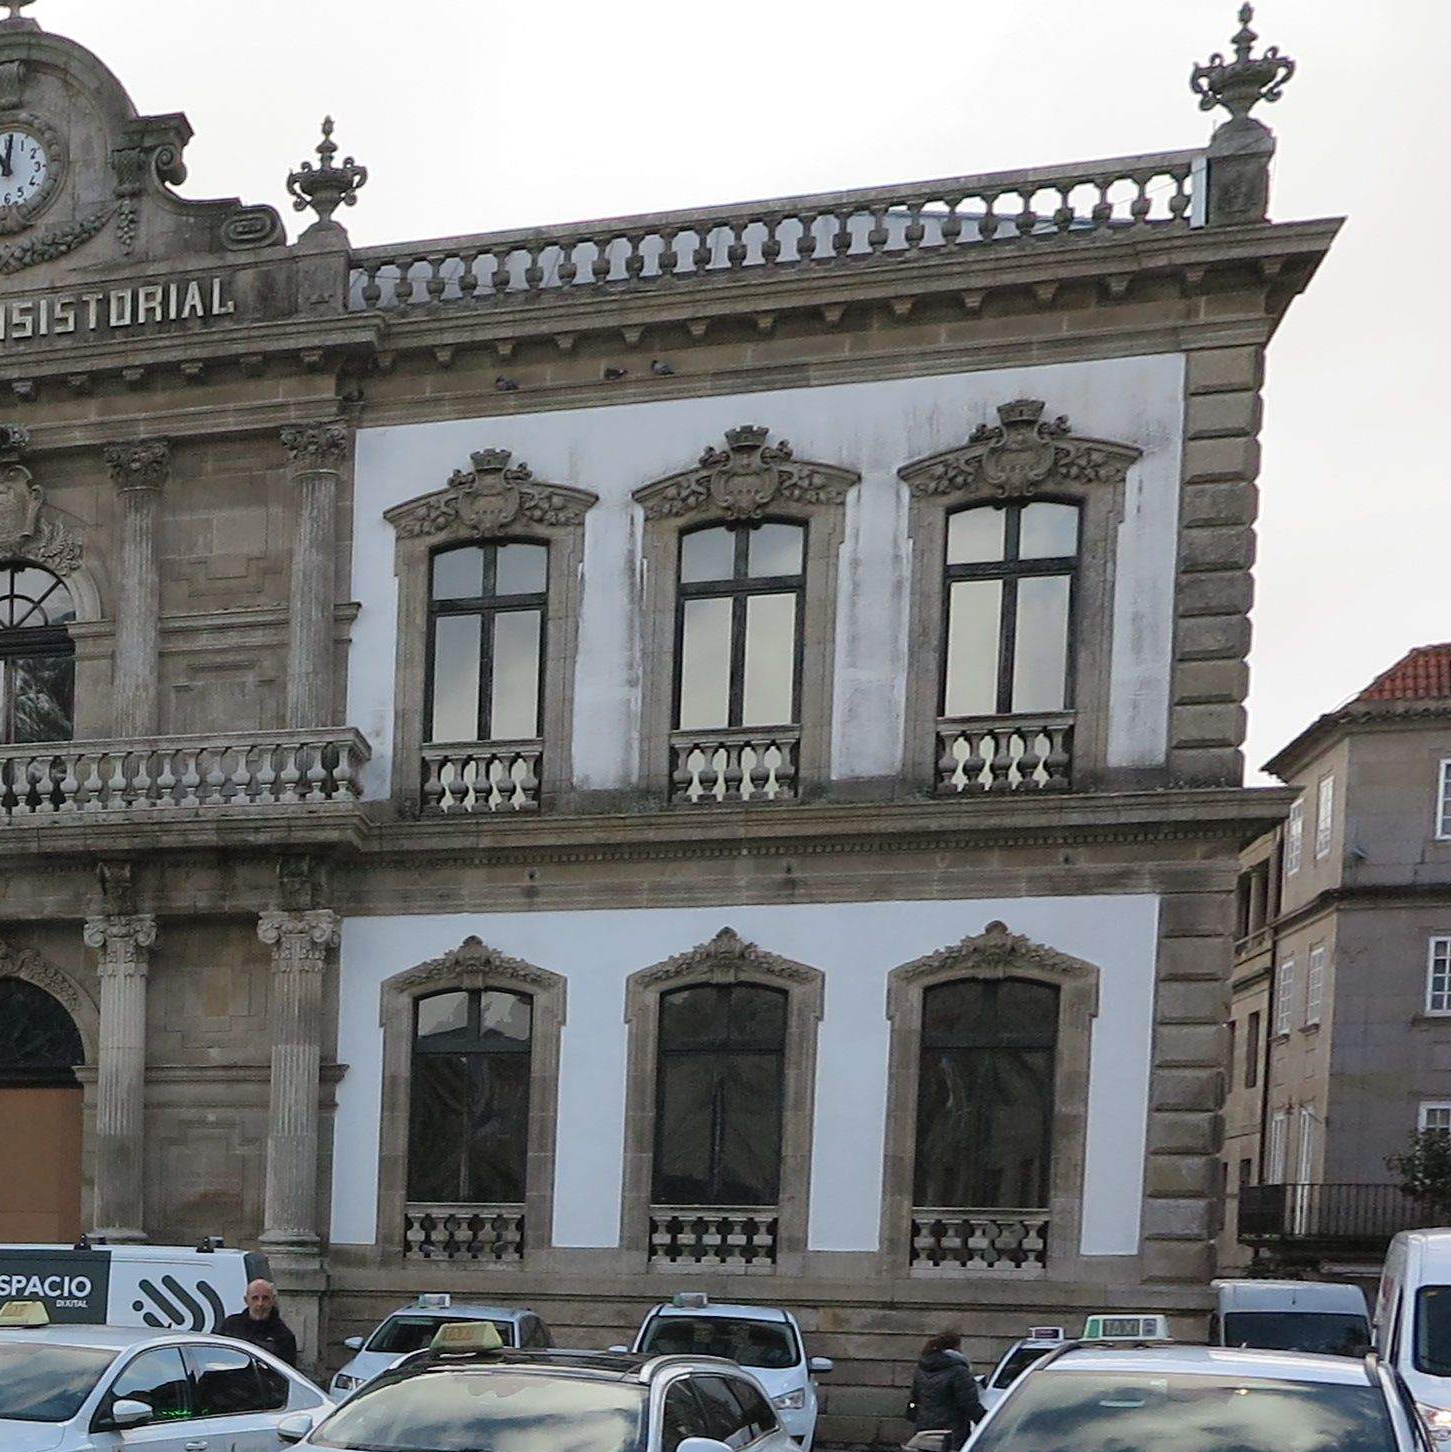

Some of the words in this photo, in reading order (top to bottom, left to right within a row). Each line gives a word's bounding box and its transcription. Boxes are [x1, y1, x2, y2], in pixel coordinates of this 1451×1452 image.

[30, 148, 37, 160] 2
[34, 161, 41, 173] 3
[29, 175, 36, 186] 4
[17, 186, 24, 198] 5
[4, 192, 11, 205] 6
